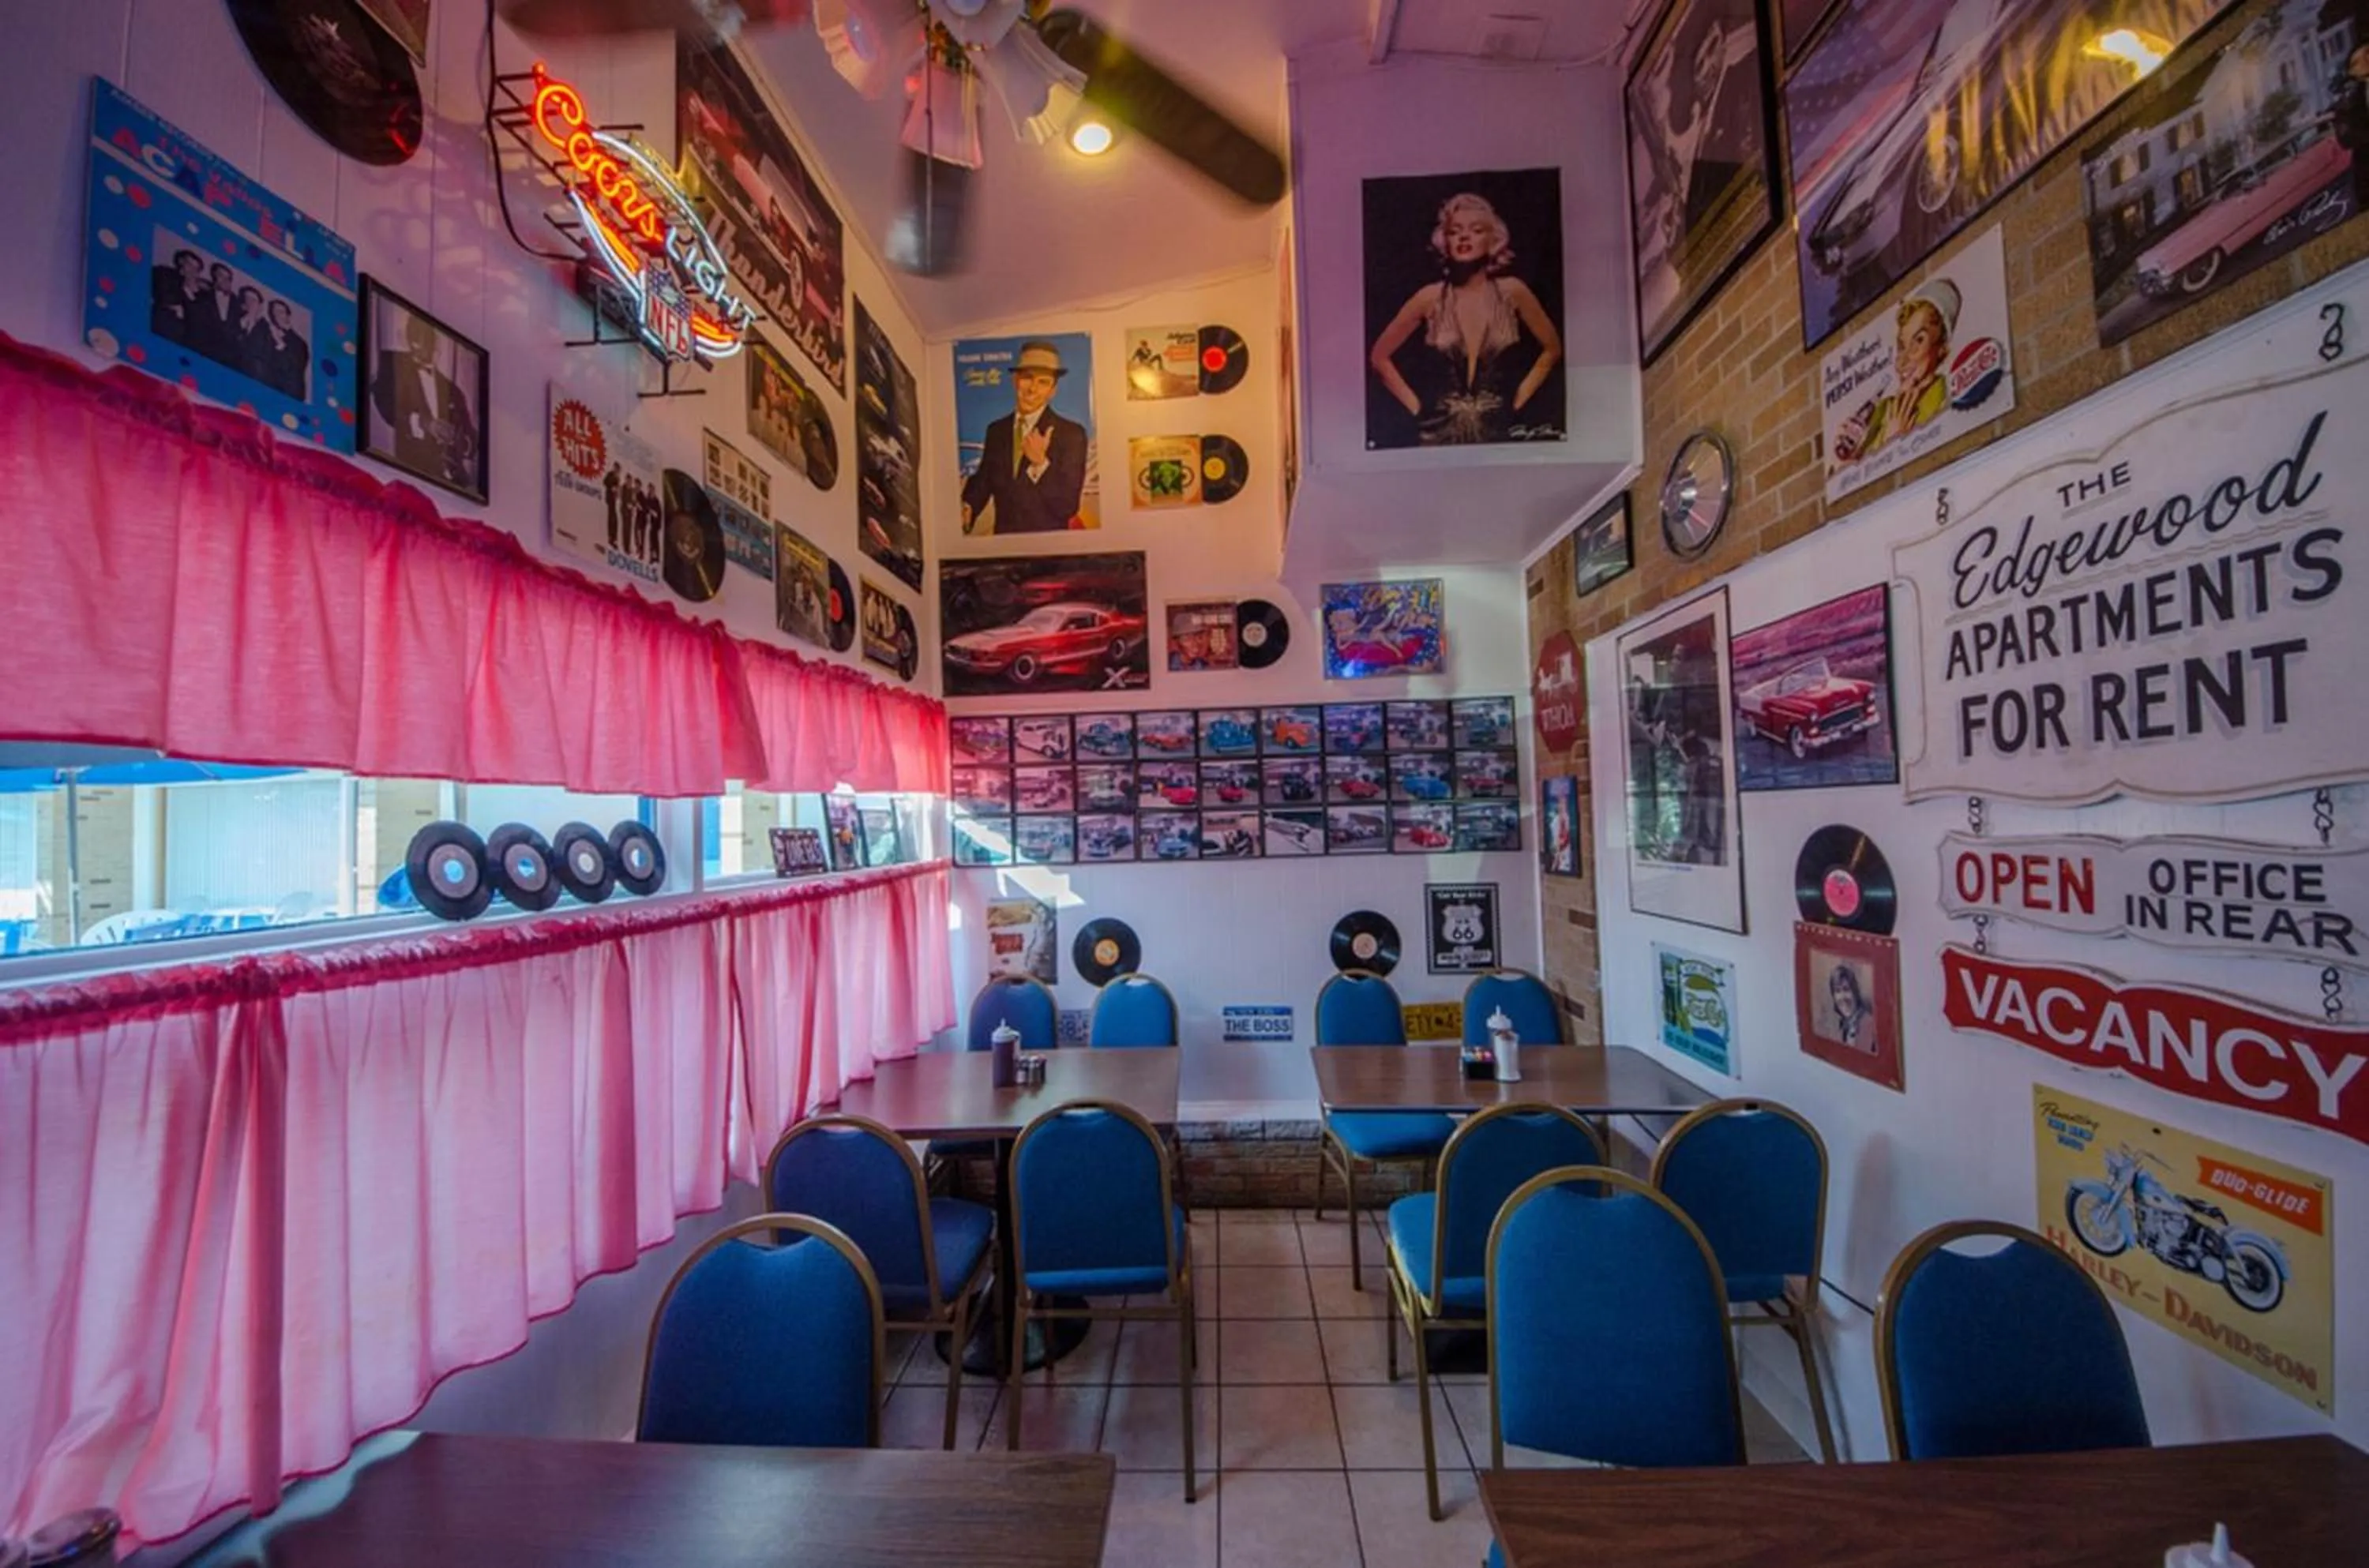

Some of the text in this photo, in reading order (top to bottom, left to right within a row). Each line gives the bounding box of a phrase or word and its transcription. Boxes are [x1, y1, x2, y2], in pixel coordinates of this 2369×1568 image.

[536, 83, 665, 242] Coors
[113, 127, 348, 286] ACAPELLA
[666, 227, 757, 330] LIGHT
[648, 298, 689, 355] NFL
[563, 408, 592, 437] ALL
[1826, 376, 1853, 409] PEPSI
[562, 437, 600, 471] HITS
[2057, 460, 2132, 508] THE
[1953, 410, 2329, 609] Edgewood
[1945, 527, 2345, 681] APARTMENTS
[1960, 638, 2308, 757] FOR RENT
[1955, 851, 2327, 915] OPEN OFFICE
[1453, 927, 1475, 940] 66
[2124, 894, 2360, 956] IN REAR
[1225, 1018, 1290, 1033] THE BOSS
[1958, 967, 2368, 1120] VACANCY
[2211, 1168, 2311, 1215] DUO-GLIDE
